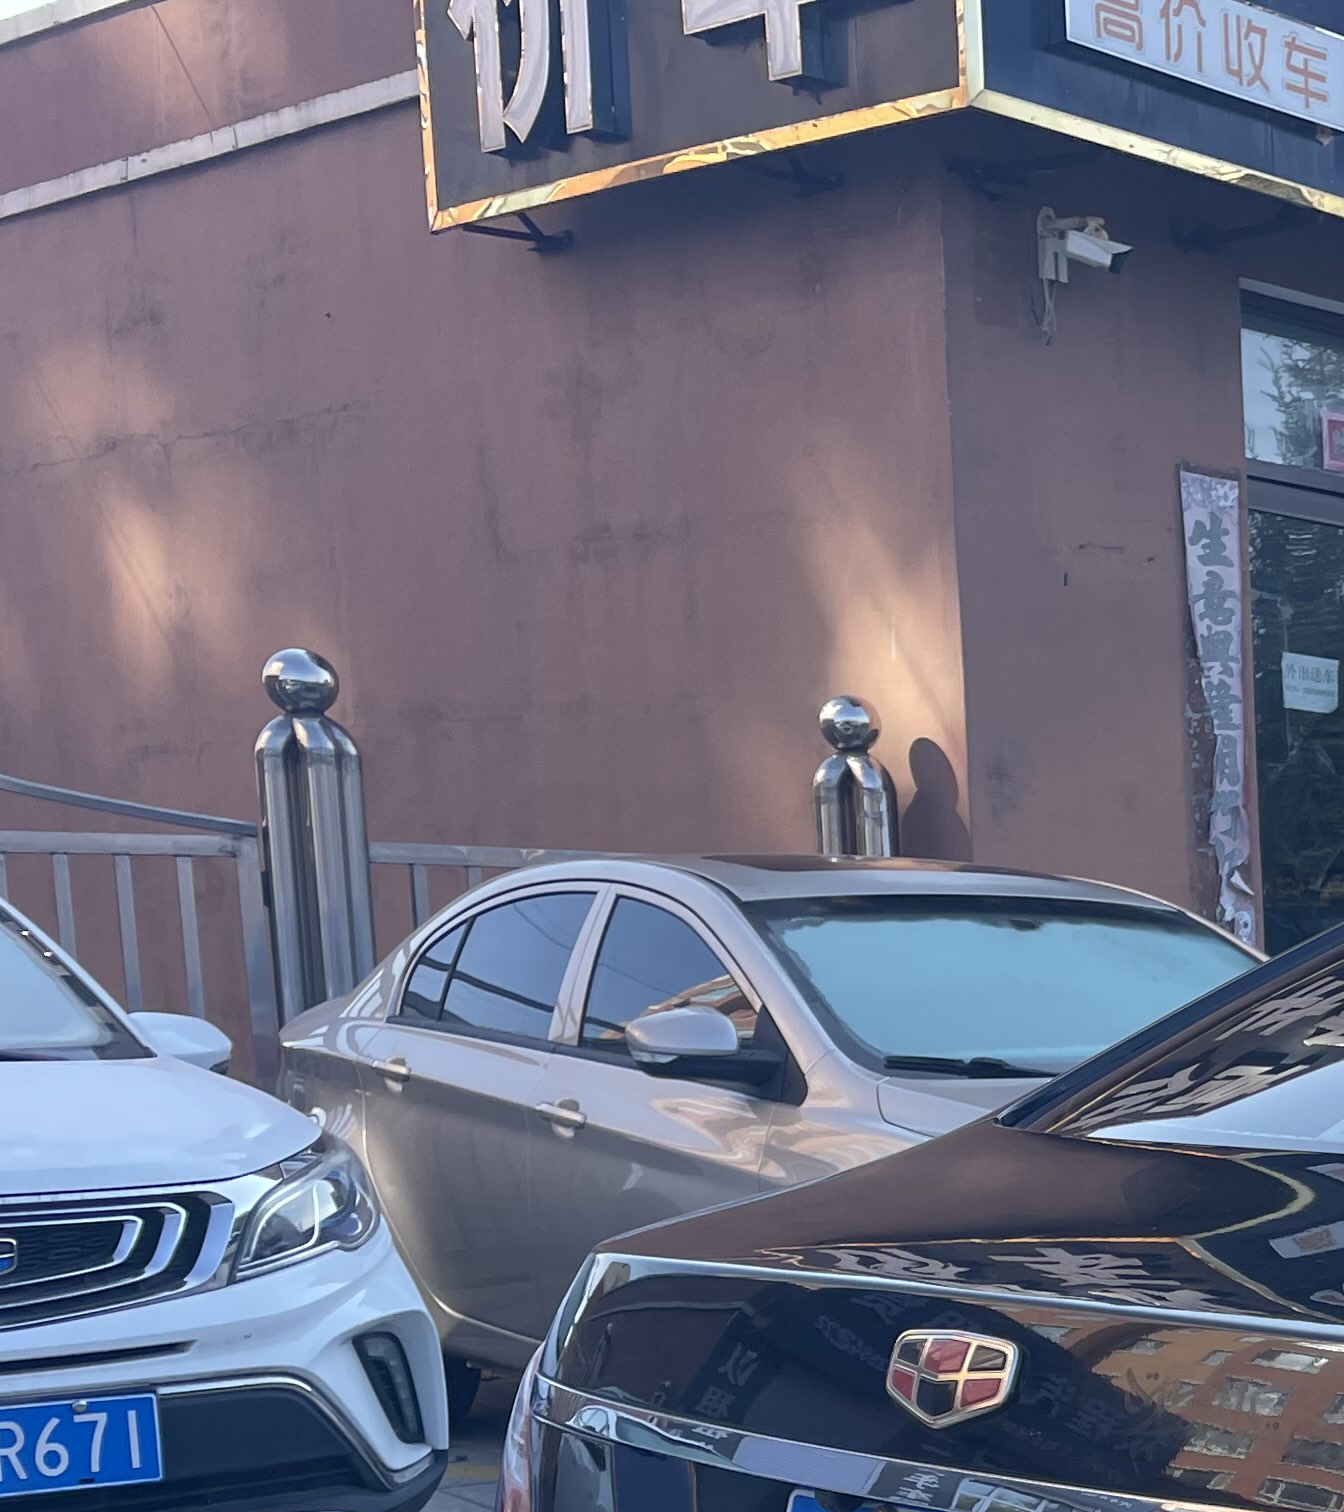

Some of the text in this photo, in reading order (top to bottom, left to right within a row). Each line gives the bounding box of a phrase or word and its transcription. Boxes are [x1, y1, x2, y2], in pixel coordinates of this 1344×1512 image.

[1094, 0, 1329, 110] 高价收车
[0, 1409, 141, 1482] R671
